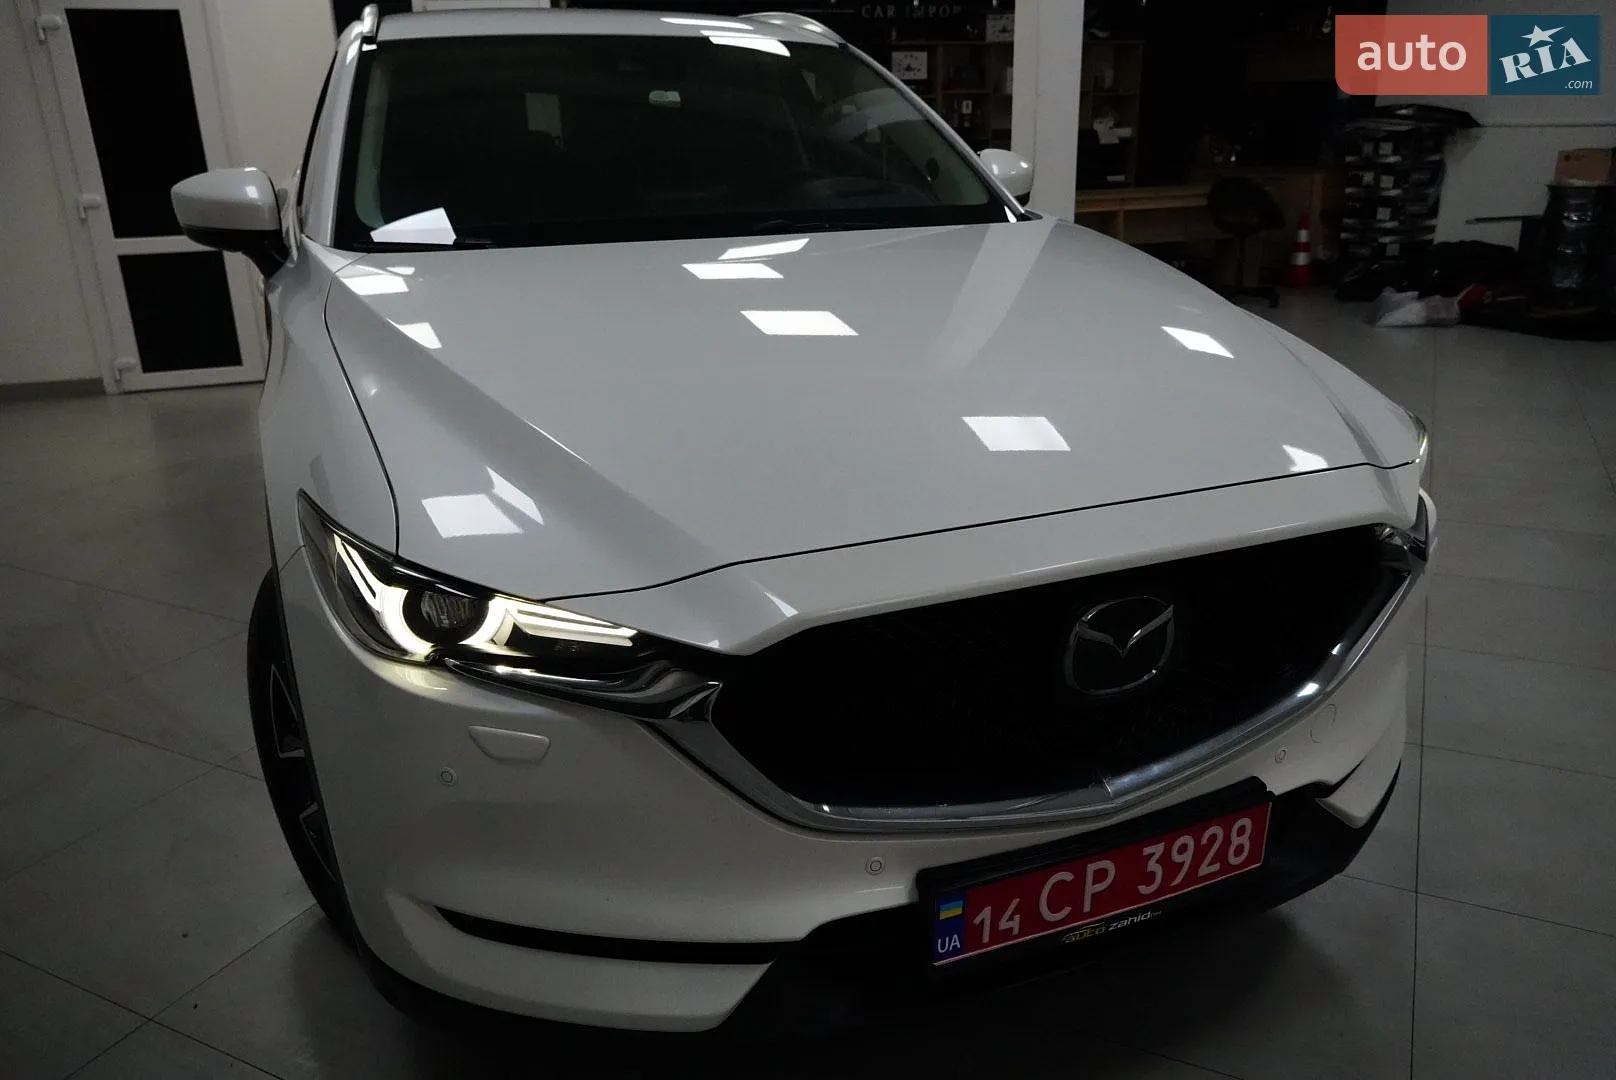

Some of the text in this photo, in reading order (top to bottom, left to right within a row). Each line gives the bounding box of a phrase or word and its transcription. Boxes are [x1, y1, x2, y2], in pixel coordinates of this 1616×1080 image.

[860, 4, 897, 19] CAR
[972, 817, 1254, 944] 14 CP 3928
[936, 934, 961, 954] UA
